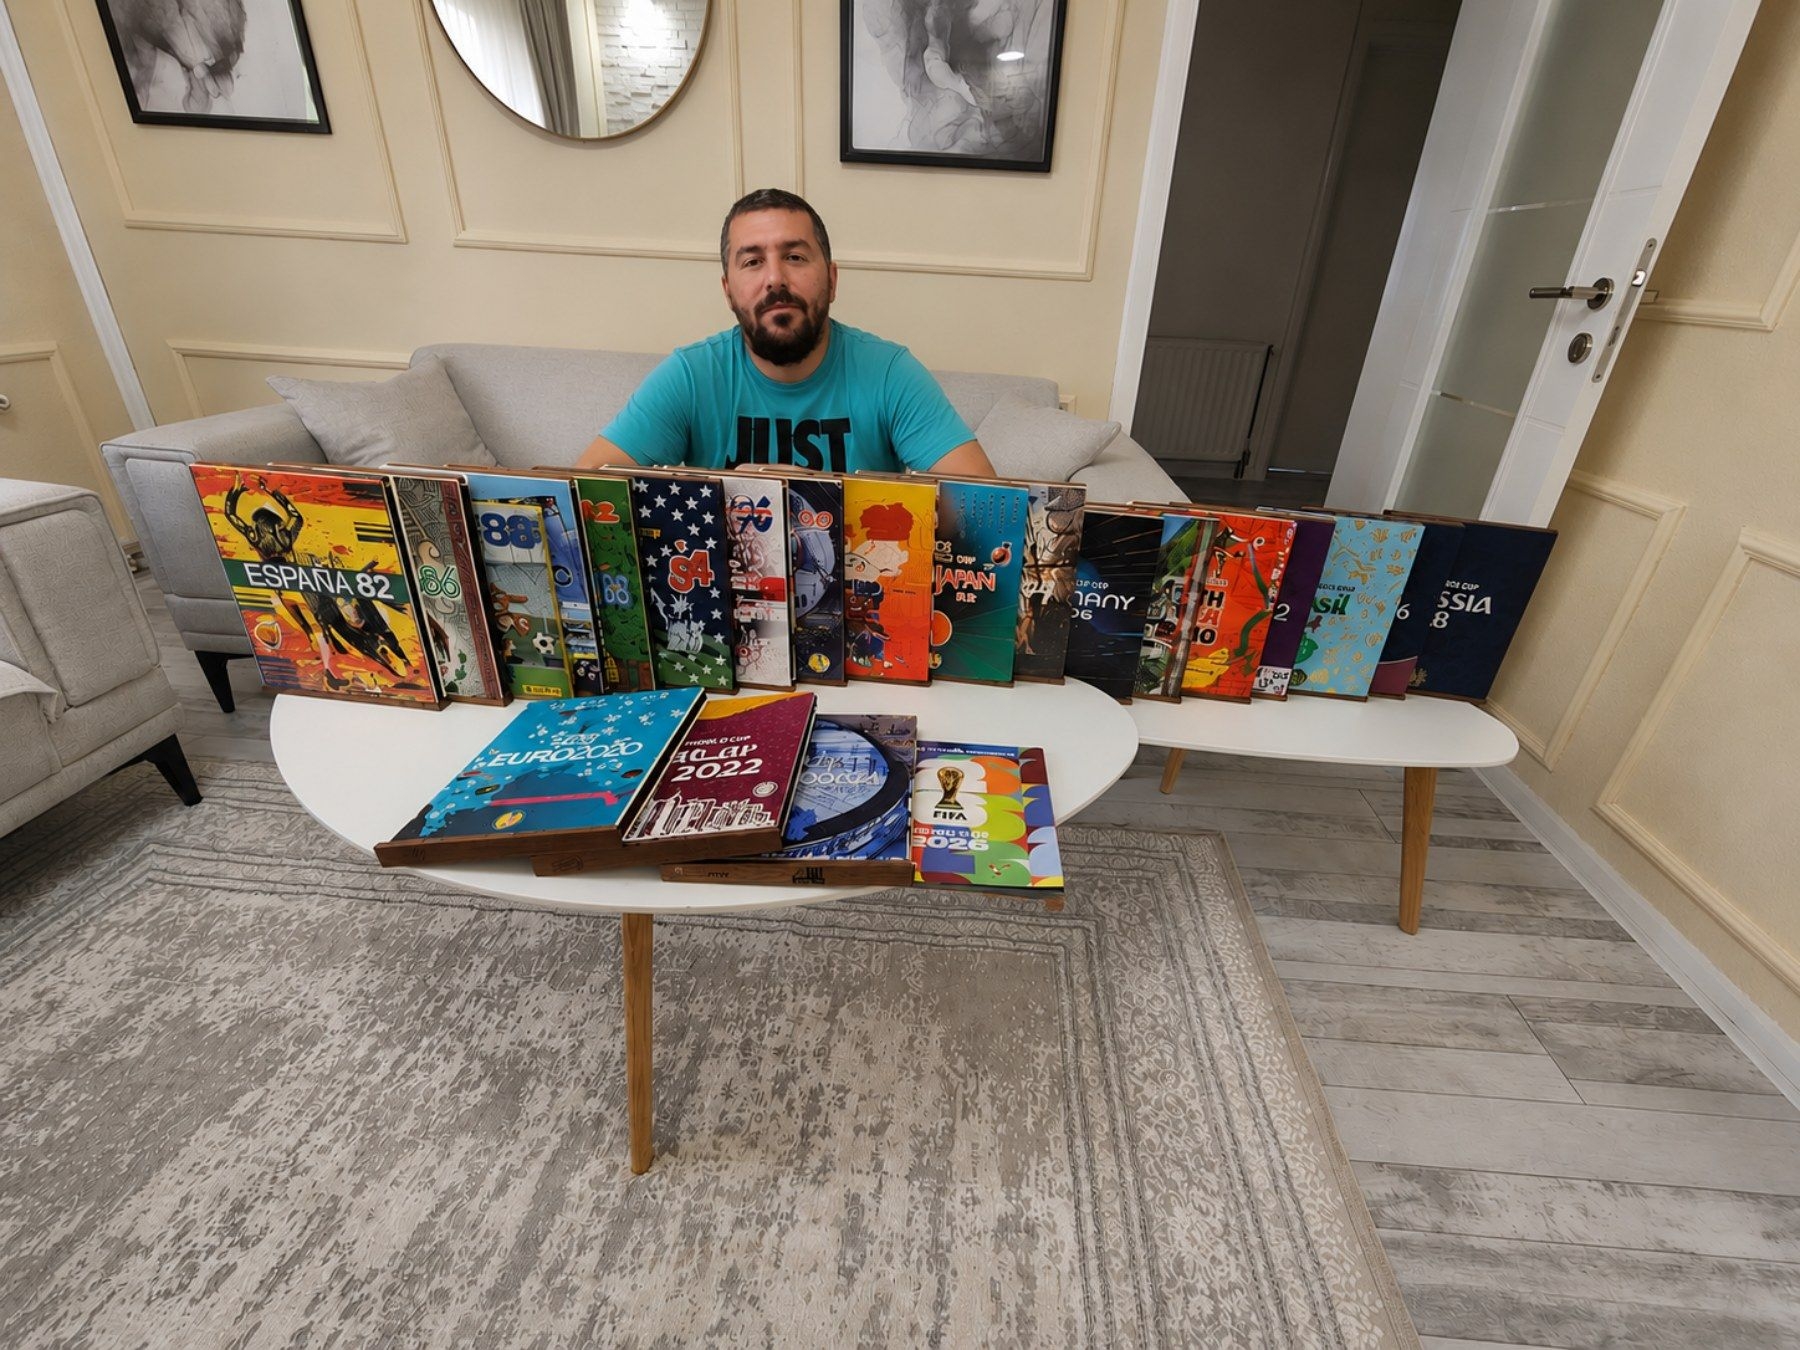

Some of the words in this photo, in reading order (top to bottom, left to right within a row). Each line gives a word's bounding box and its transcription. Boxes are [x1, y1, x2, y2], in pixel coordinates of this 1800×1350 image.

[725, 416, 851, 472] JUST
[243, 562, 354, 596] ESPAÑA
[355, 572, 395, 600] 82
[419, 565, 460, 598] 86
[933, 564, 996, 595] JAPAN
[1273, 603, 1290, 621] 2
[1396, 603, 1410, 619] 6
[671, 758, 763, 782] 2022
[912, 834, 990, 851] 2026
